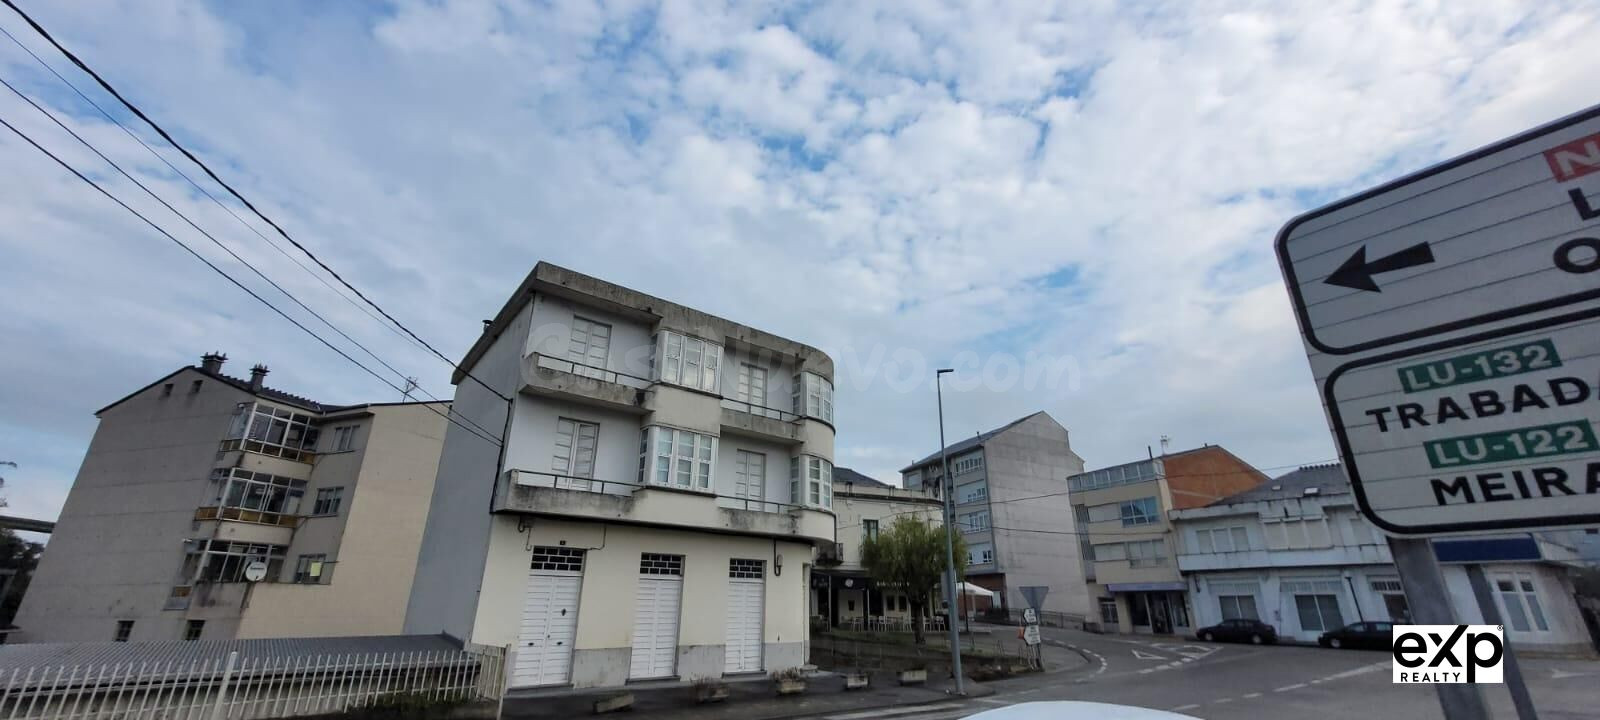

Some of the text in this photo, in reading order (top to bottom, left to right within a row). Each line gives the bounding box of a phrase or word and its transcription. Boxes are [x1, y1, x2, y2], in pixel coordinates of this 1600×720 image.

[1405, 345, 1553, 390] LU-132
[1365, 370, 1600, 433] TRABAD
[1433, 425, 1590, 465] LU-122
